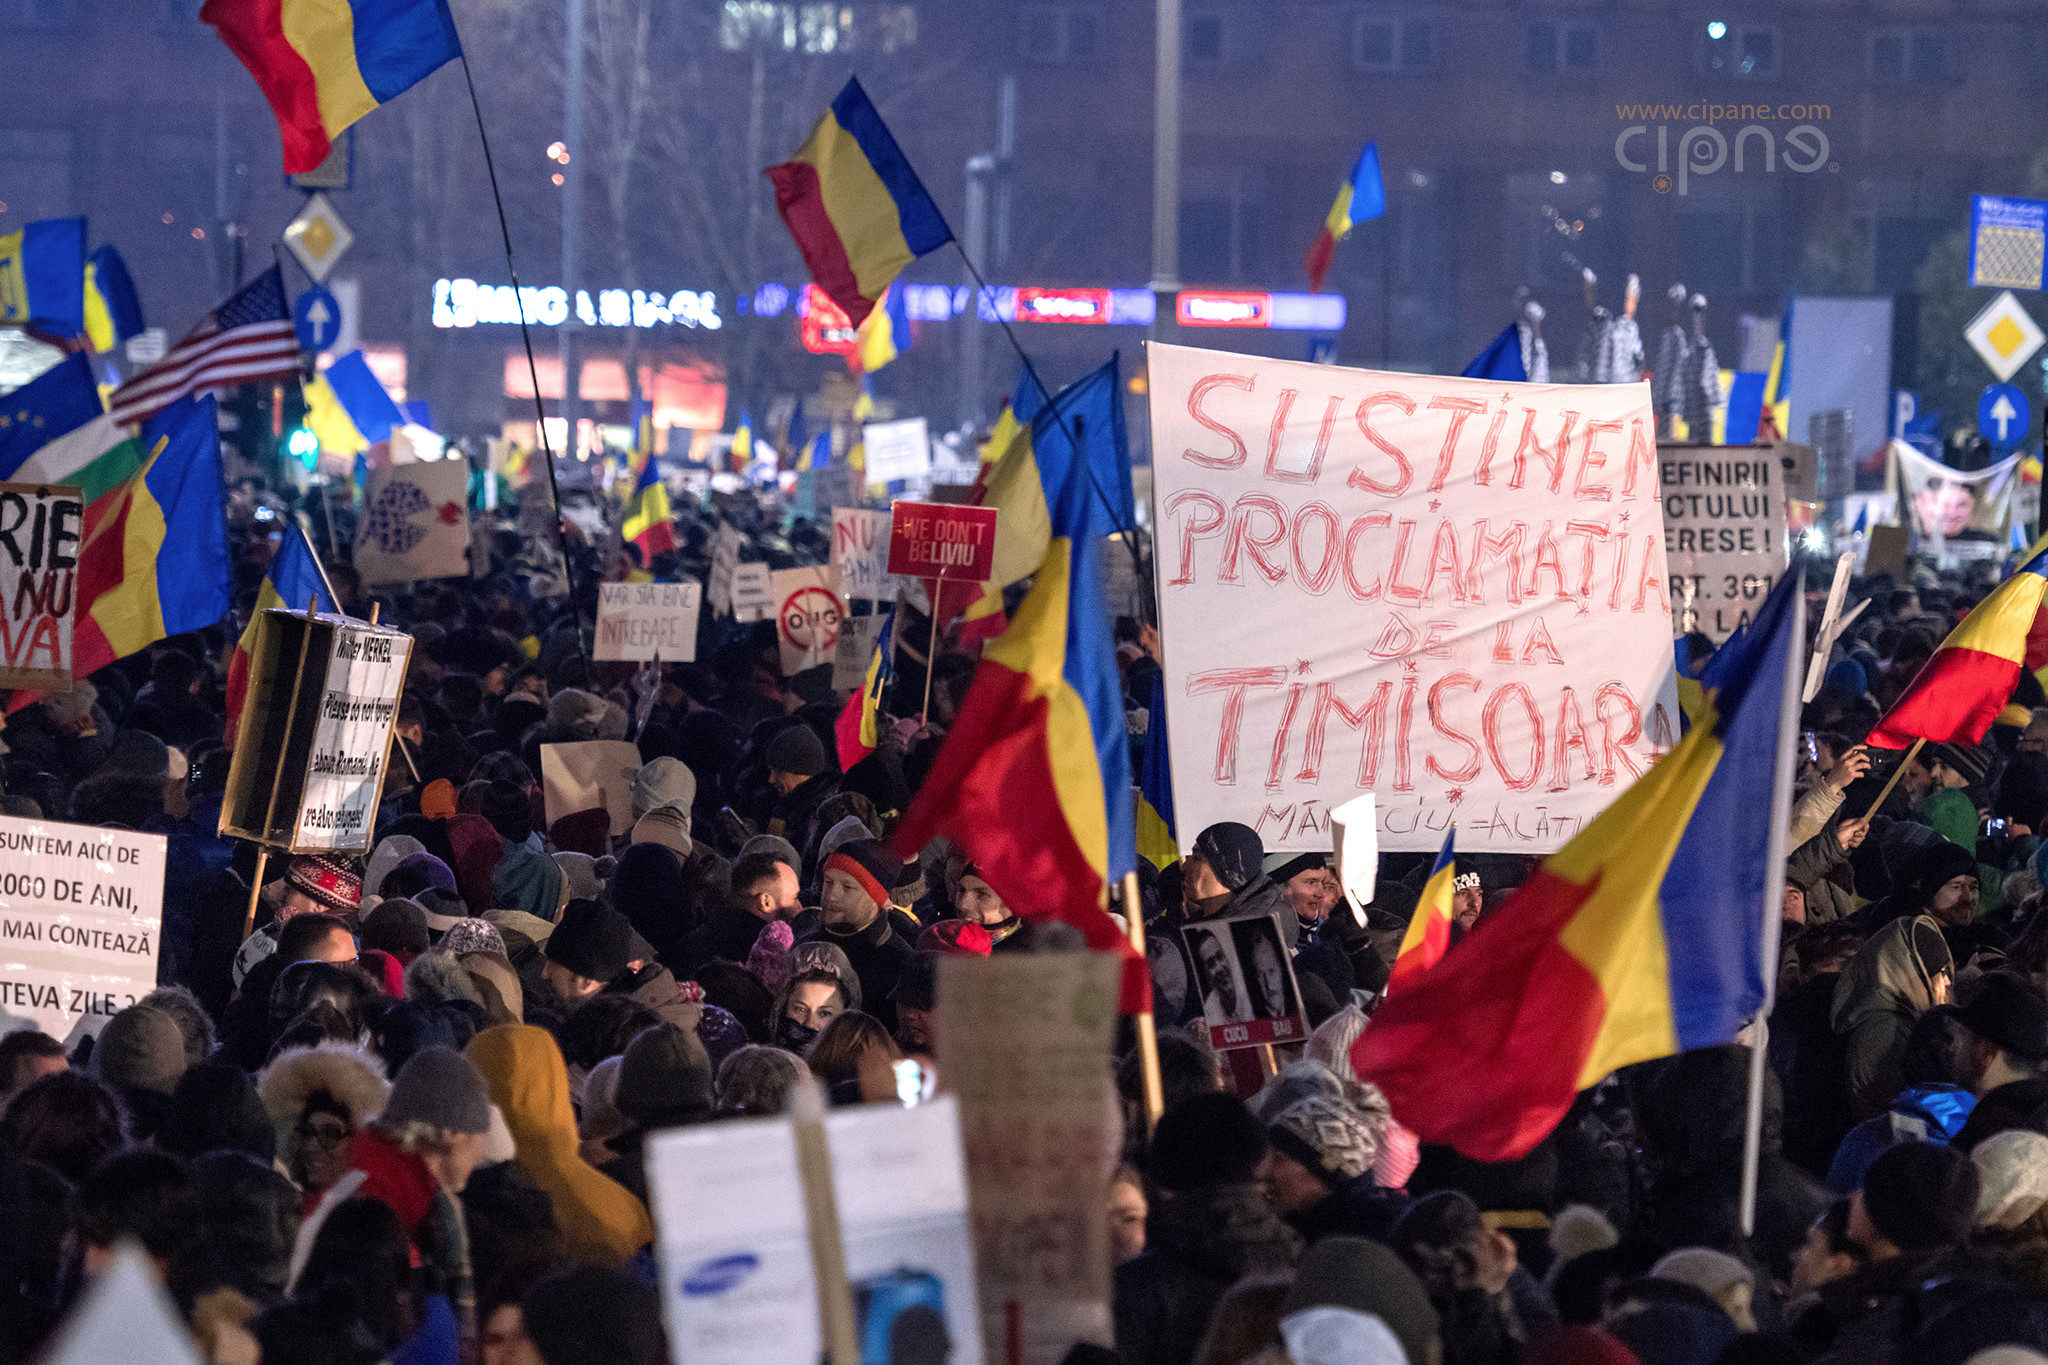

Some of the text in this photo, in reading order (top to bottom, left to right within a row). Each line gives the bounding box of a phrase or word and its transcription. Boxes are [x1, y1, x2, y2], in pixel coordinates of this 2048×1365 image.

[1665, 494, 1769, 519] CTULUI
[837, 516, 876, 552] NU
[903, 516, 931, 540] WE
[908, 540, 976, 567] BELIVIU
[13, 569, 74, 621] NU
[1366, 612, 1564, 665] DE LA
[350, 696, 361, 722] do
[0, 831, 141, 866] SUNTEM AICI DE
[54, 878, 84, 904] DE
[90, 883, 139, 915] ANI,
[2, 919, 152, 957] MAI CONTEAZĂ
[69, 989, 118, 1017] ZILE
